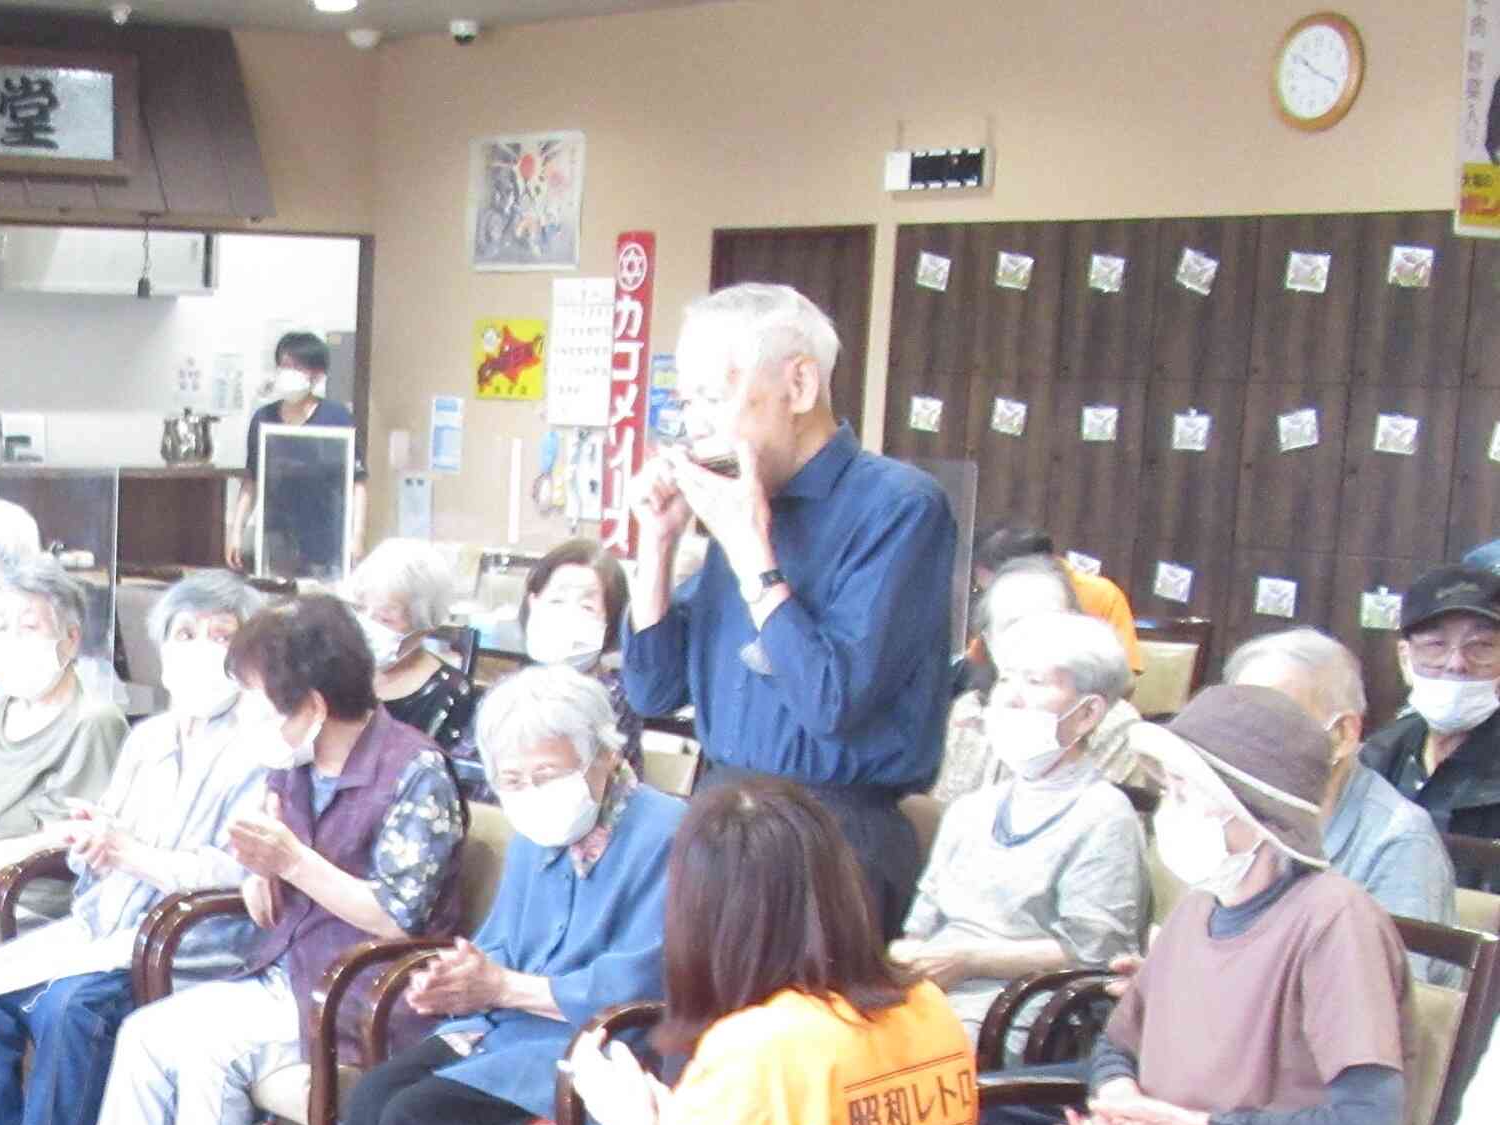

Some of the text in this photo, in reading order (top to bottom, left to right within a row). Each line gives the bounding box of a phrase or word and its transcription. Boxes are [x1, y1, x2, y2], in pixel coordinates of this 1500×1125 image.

[601, 295, 644, 549] カゴメソース
